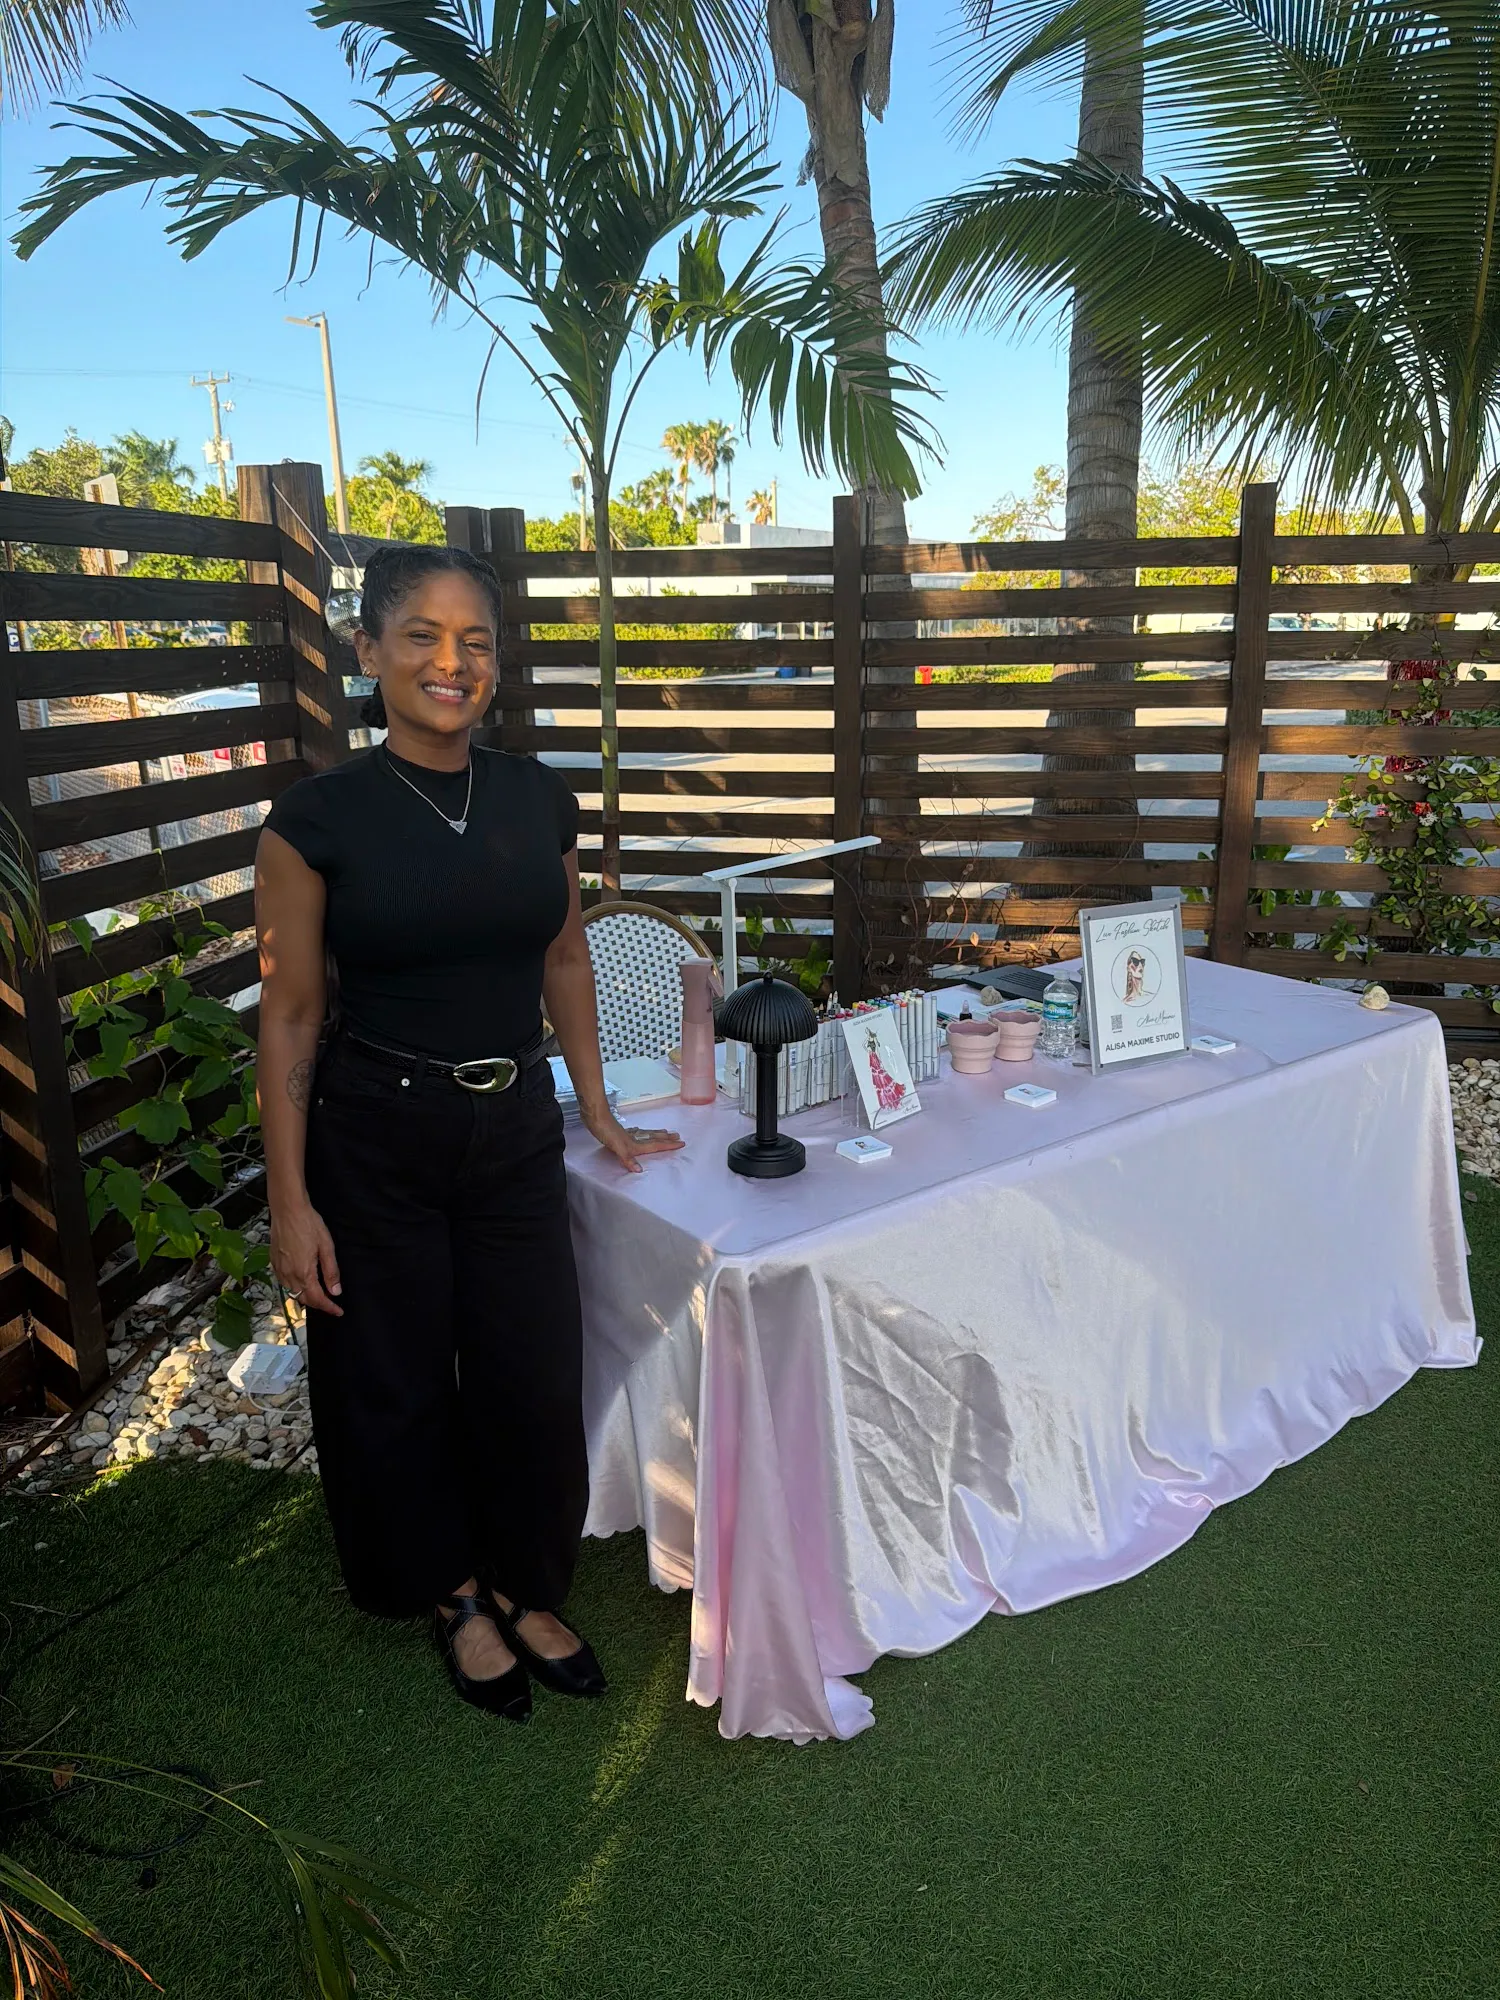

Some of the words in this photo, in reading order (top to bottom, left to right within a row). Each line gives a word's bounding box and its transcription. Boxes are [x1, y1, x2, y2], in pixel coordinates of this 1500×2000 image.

[1105, 1041, 1126, 1052] ALISA
[1127, 1036, 1154, 1048] MAXIME
[1155, 1031, 1180, 1043] STUDIO
